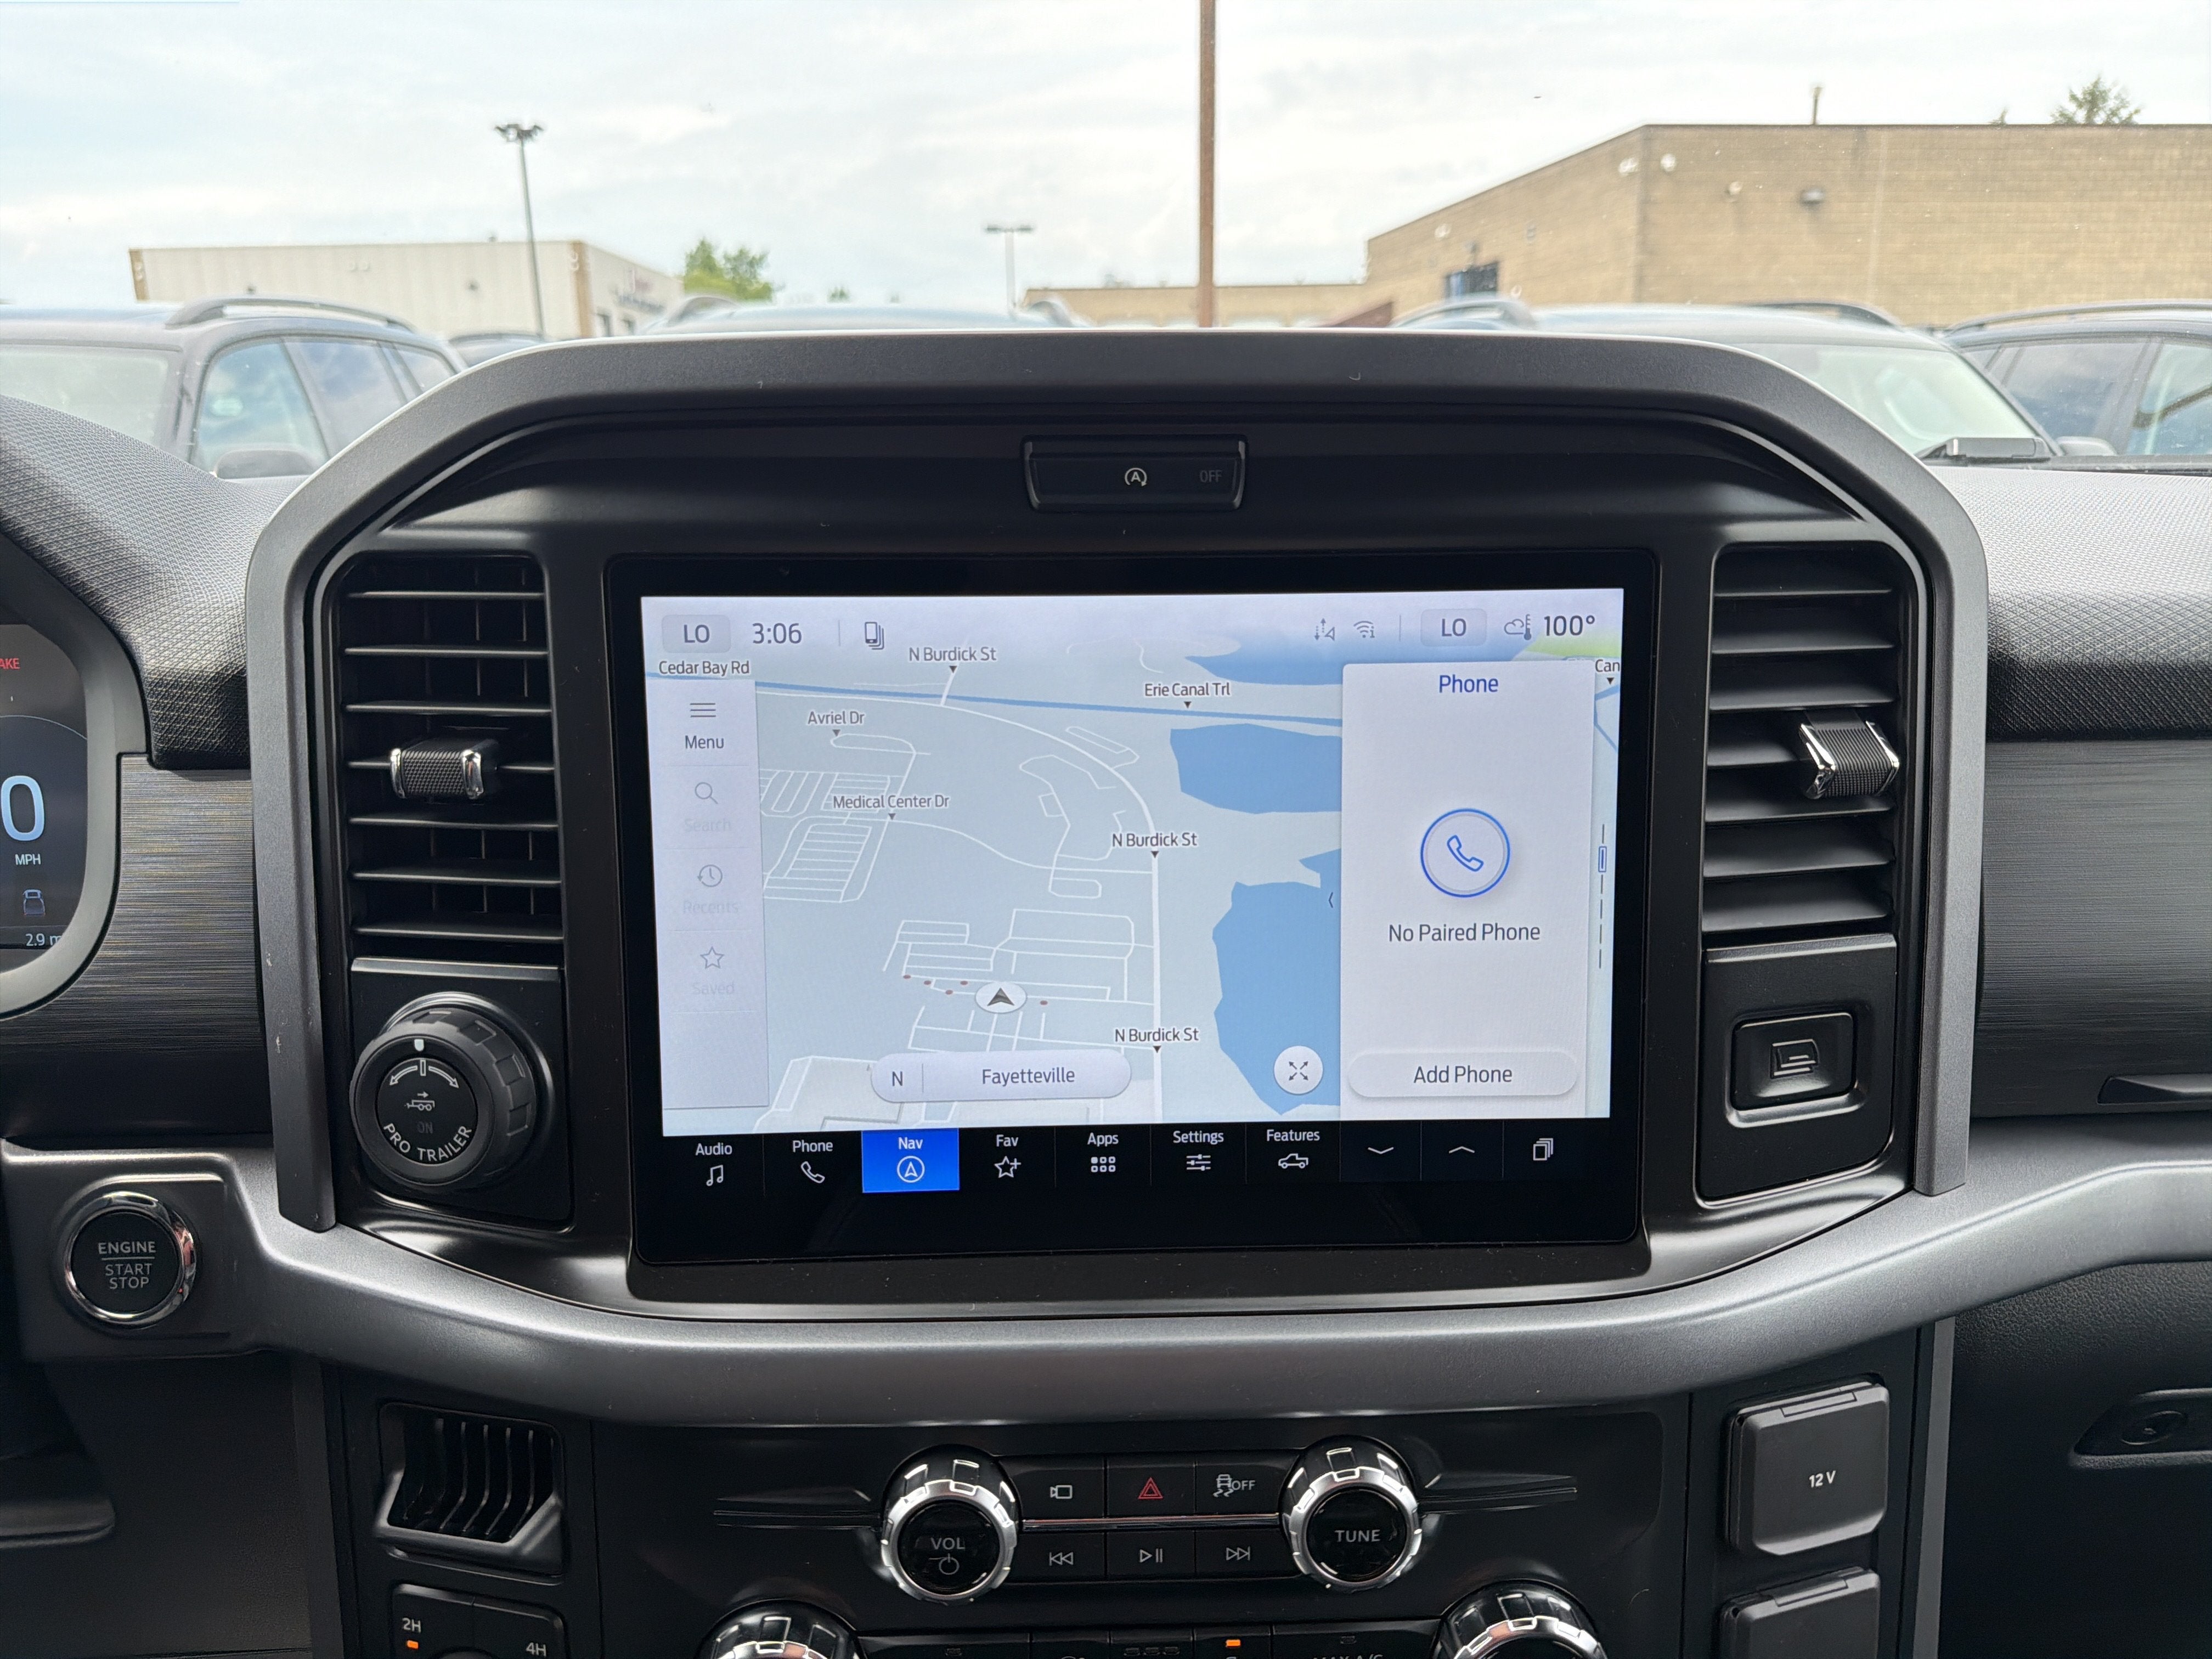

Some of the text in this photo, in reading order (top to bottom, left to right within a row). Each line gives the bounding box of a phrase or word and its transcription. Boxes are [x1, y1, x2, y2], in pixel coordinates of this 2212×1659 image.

[1199, 470, 1223, 483] OFF
[1441, 618, 1467, 637] LO
[1544, 615, 1596, 636] 100°
[683, 624, 710, 643] LO
[752, 623, 803, 644] 3:06
[909, 646, 996, 662] N Burdick St
[658, 661, 750, 676] Cedar Bay Rd
[1595, 659, 1620, 673] Can
[1145, 682, 1231, 696] Erie Canal Trl
[1438, 675, 1499, 693] Phone
[808, 710, 865, 725] Avriel Dr
[685, 735, 725, 749] Menu
[0, 775, 45, 842] 0
[833, 795, 950, 809] Medical Center Dr
[684, 819, 731, 832] Search
[1112, 833, 1198, 847] N Burdick St
[15, 854, 41, 865] MPH
[683, 901, 738, 915] Recents
[25, 933, 45, 946] 2.9
[1389, 923, 1541, 942] No Paired Phone
[692, 981, 735, 996] Saved
[1115, 1028, 1199, 1042] N Burdick St
[891, 1071, 904, 1086] N
[981, 1067, 1075, 1087] Fayetteville
[1413, 1065, 1513, 1084] Add Phone
[383, 1124, 472, 1161] PRO TRAILER
[996, 1135, 1019, 1148] Fav
[1087, 1132, 1119, 1147] Apps
[1172, 1131, 1224, 1146] Settings
[1266, 1129, 1321, 1143] Features
[695, 1142, 732, 1156] Audio
[792, 1140, 833, 1153] Phone
[898, 1137, 923, 1150] Nav
[98, 1240, 157, 1255] ENGINE
[105, 1263, 153, 1277] START
[110, 1276, 150, 1289] STOP
[1232, 1480, 1256, 1491] OFF
[1809, 1470, 1836, 1488] 12 V
[1334, 1529, 1381, 1543] TUNE
[931, 1537, 966, 1550] VOL
[402, 1617, 422, 1633] 2H
[526, 1643, 546, 1657] 4H
